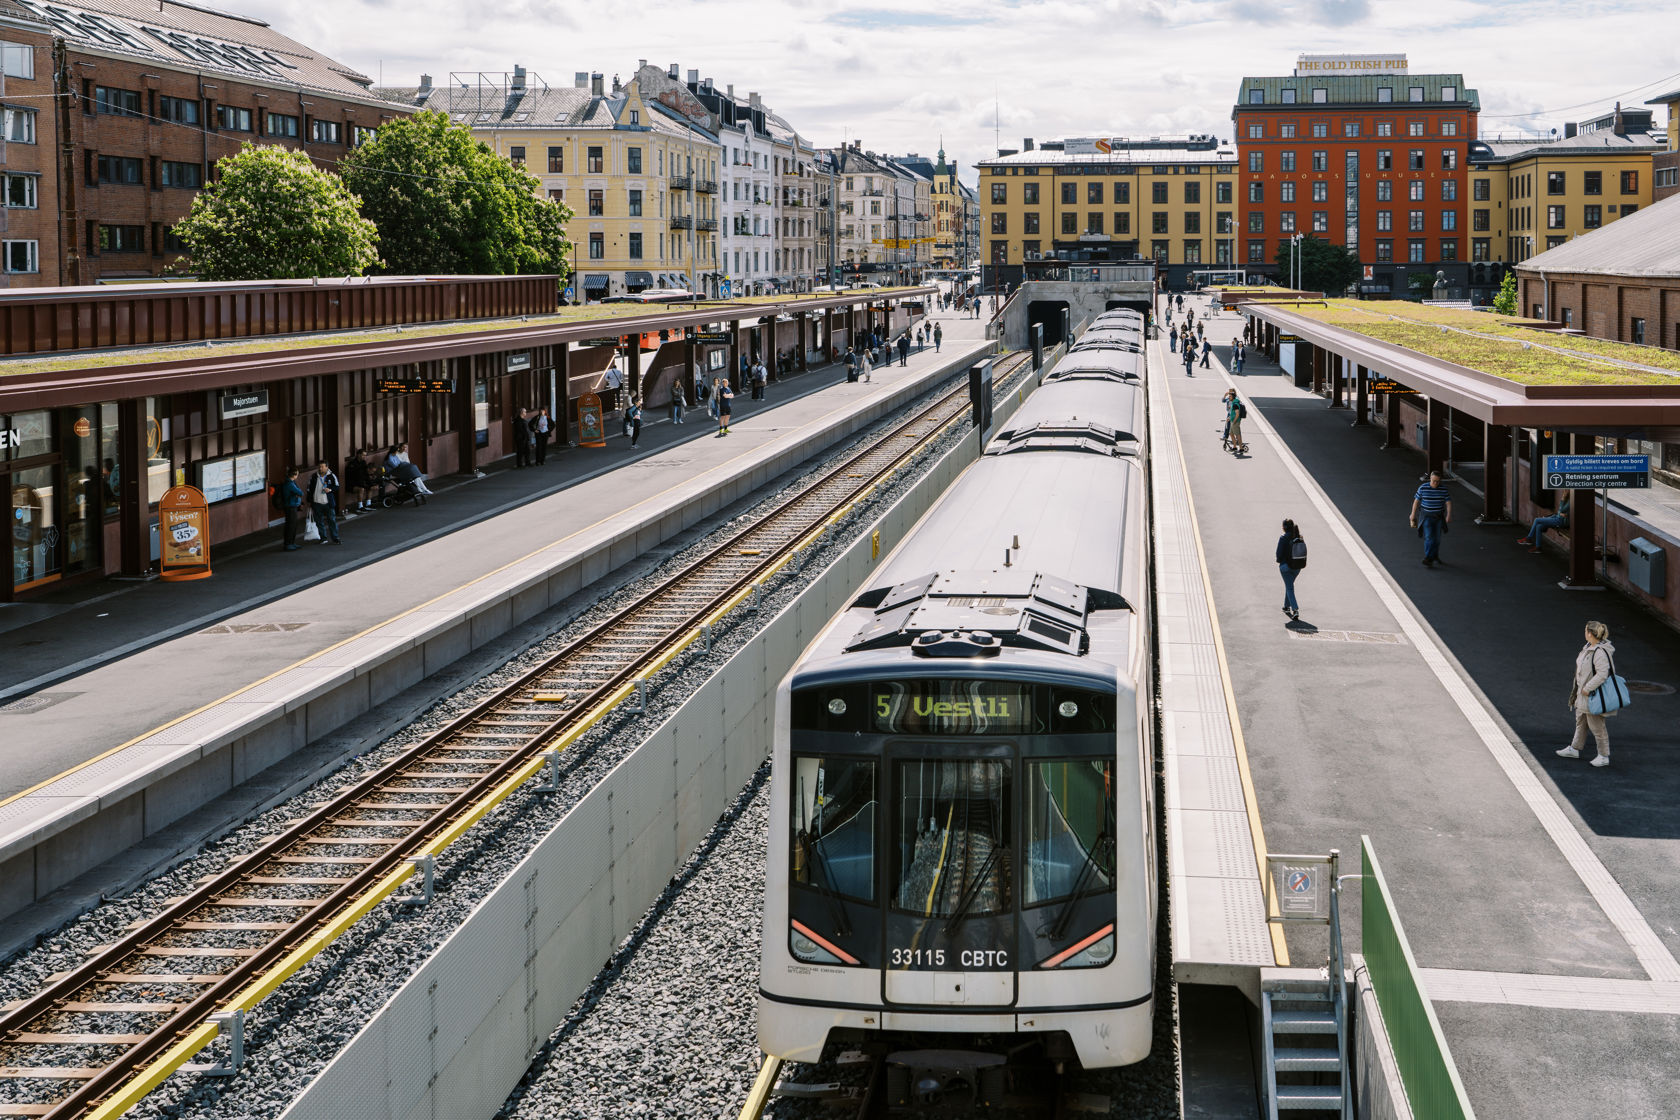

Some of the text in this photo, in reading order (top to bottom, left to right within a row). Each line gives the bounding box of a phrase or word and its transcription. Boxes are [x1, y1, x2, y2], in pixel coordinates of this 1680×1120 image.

[1297, 60, 1408, 70] THE OLD IRISH PUB
[233, 396, 258, 407] Majorstuen
[1565, 473, 1591, 481] Retning
[176, 530, 191, 540] 35
[876, 695, 890, 718] 5
[913, 695, 1010, 718] Vestli
[891, 949, 1008, 967] 33115 CBTC
